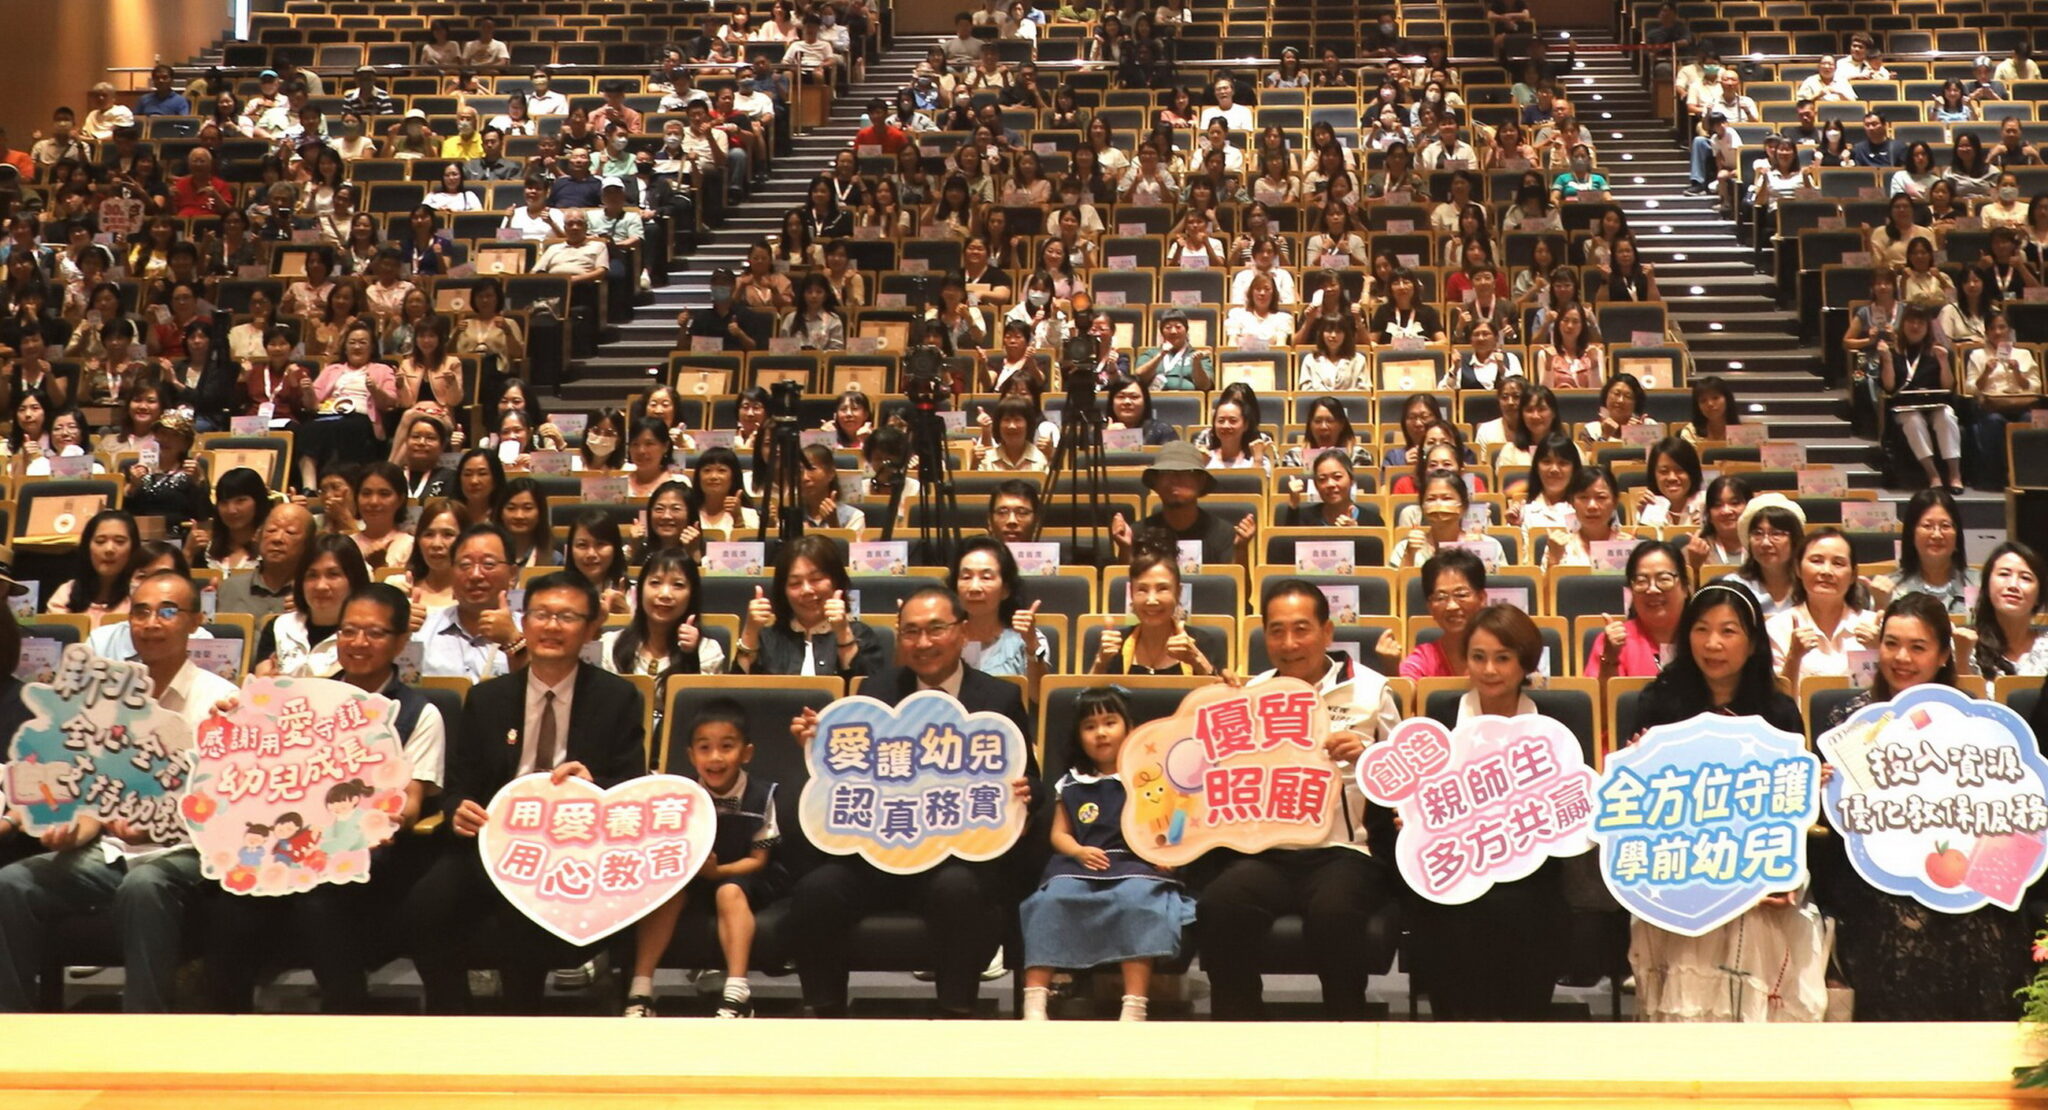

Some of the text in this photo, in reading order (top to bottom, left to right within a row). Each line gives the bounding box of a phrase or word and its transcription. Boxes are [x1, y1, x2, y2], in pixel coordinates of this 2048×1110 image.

[53, 647, 149, 710] 新北
[60, 711, 191, 791] 全心全意
[200, 697, 369, 758] 感謝用愛守護
[827, 724, 1005, 778] 愛護幼兒
[1195, 691, 1317, 761] 優質
[217, 737, 384, 803] 幼兒成長
[1367, 730, 1449, 797] 創造
[1422, 743, 1554, 827] 親師生
[1599, 760, 1810, 828] 全方位守護
[1866, 740, 2025, 789] 投入資源
[509, 797, 690, 842] 用愛養育
[832, 784, 1001, 840] 認真務實
[1205, 765, 1332, 824] 照顧
[1837, 793, 2048, 837] 優化教保服務
[1425, 778, 1592, 888] 多方共贏
[1615, 826, 1794, 882] 學前幼兒
[500, 842, 685, 897] 用心教育
